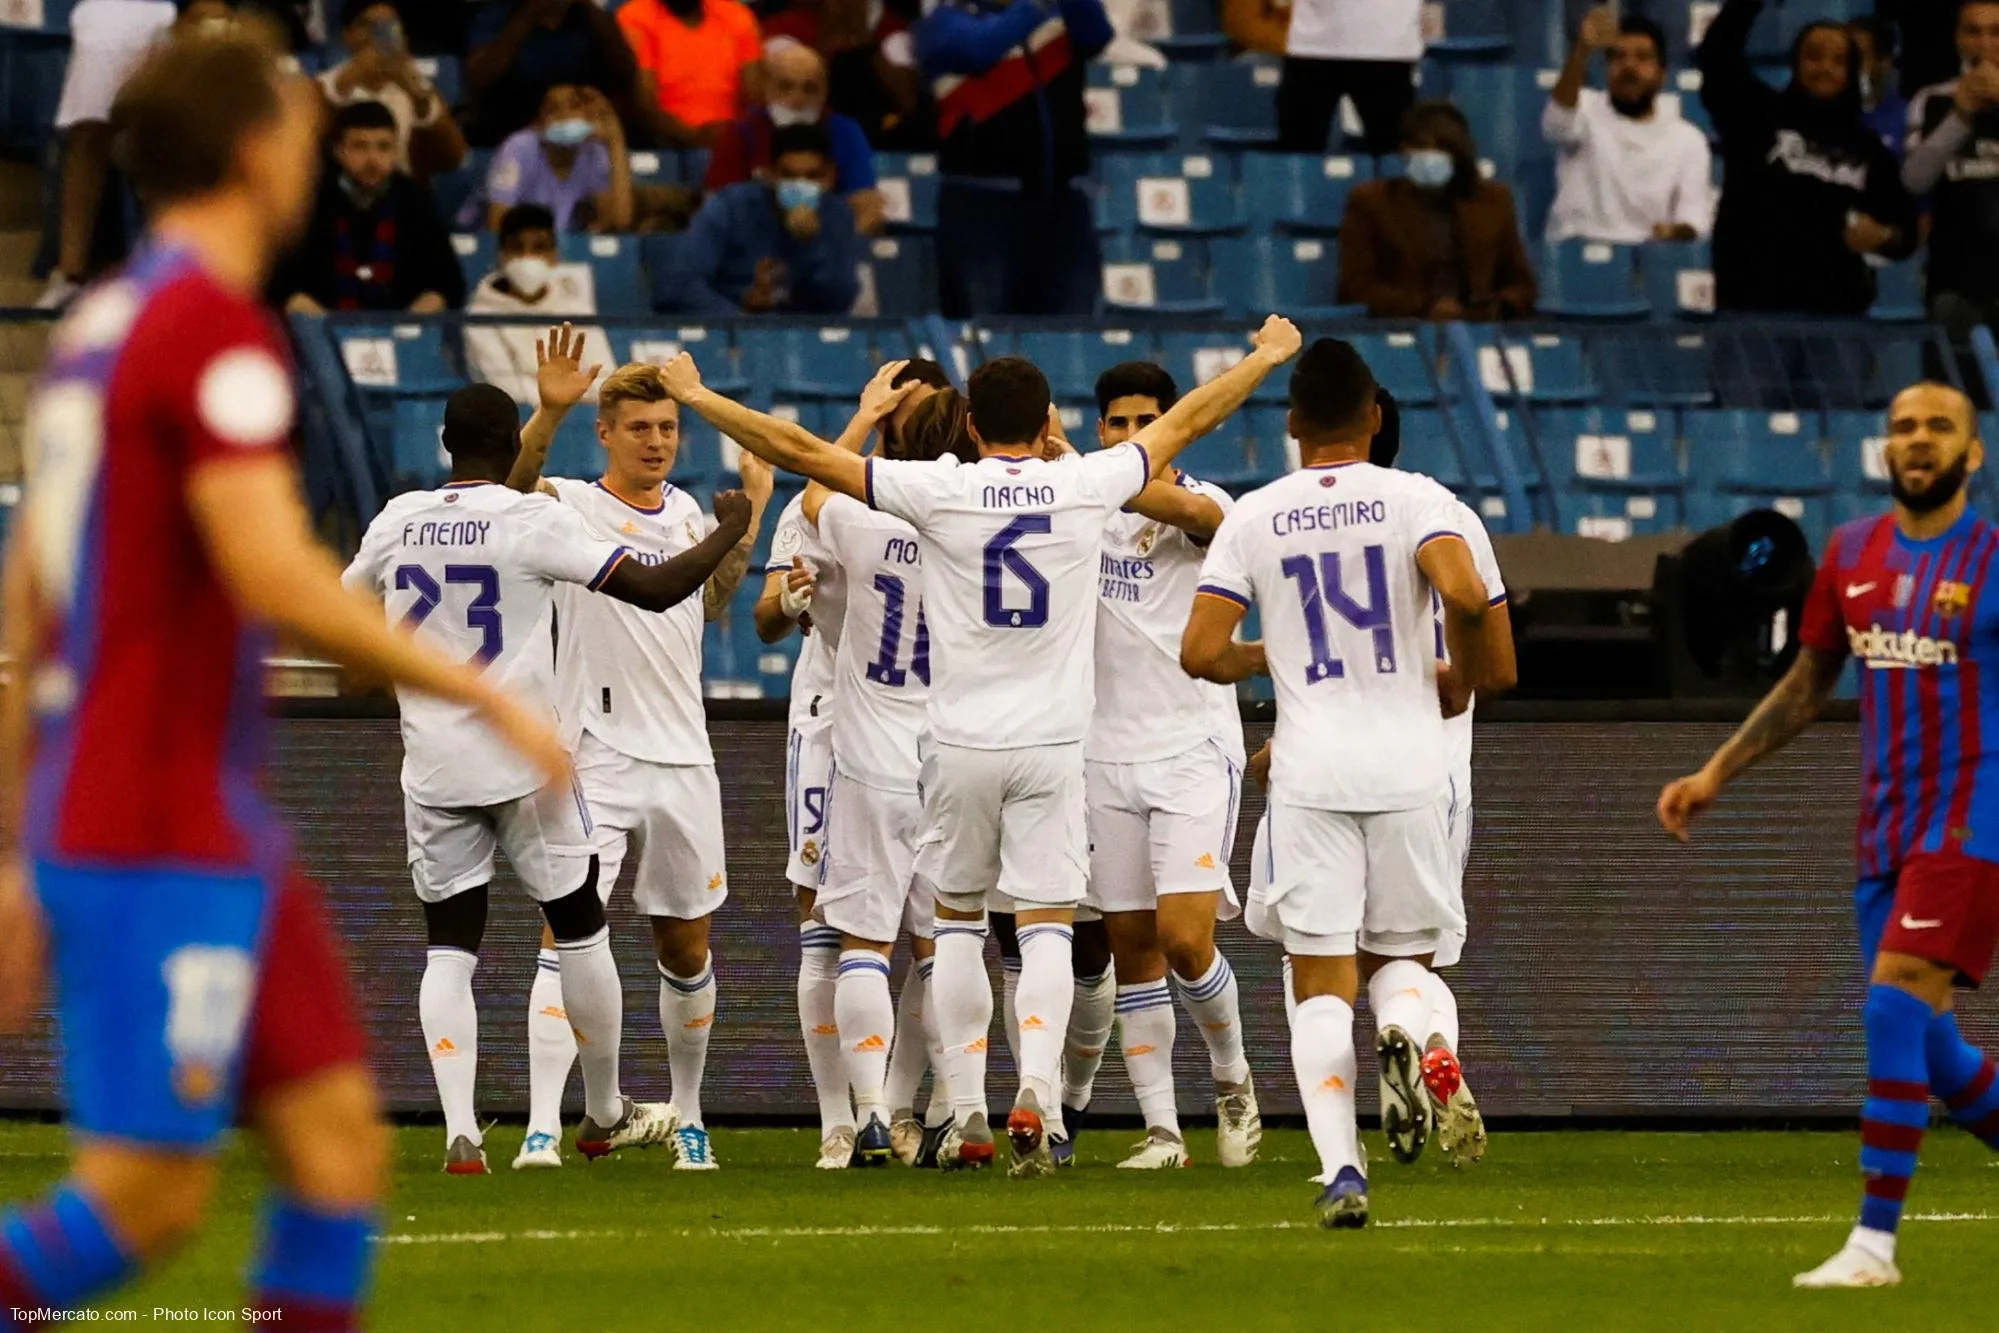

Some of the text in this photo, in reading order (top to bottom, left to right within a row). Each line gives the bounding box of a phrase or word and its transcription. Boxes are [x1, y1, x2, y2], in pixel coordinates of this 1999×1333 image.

[983, 485, 1055, 508] NACHO
[402, 520, 490, 546] F.MENDY
[1272, 500, 1386, 536] CASEMIRO
[884, 538, 922, 566] MO
[983, 514, 1051, 628] 6
[1102, 578, 1140, 602] BETTER
[395, 564, 503, 674] 23
[1281, 544, 1397, 685] 14
[803, 787, 825, 835] 9
